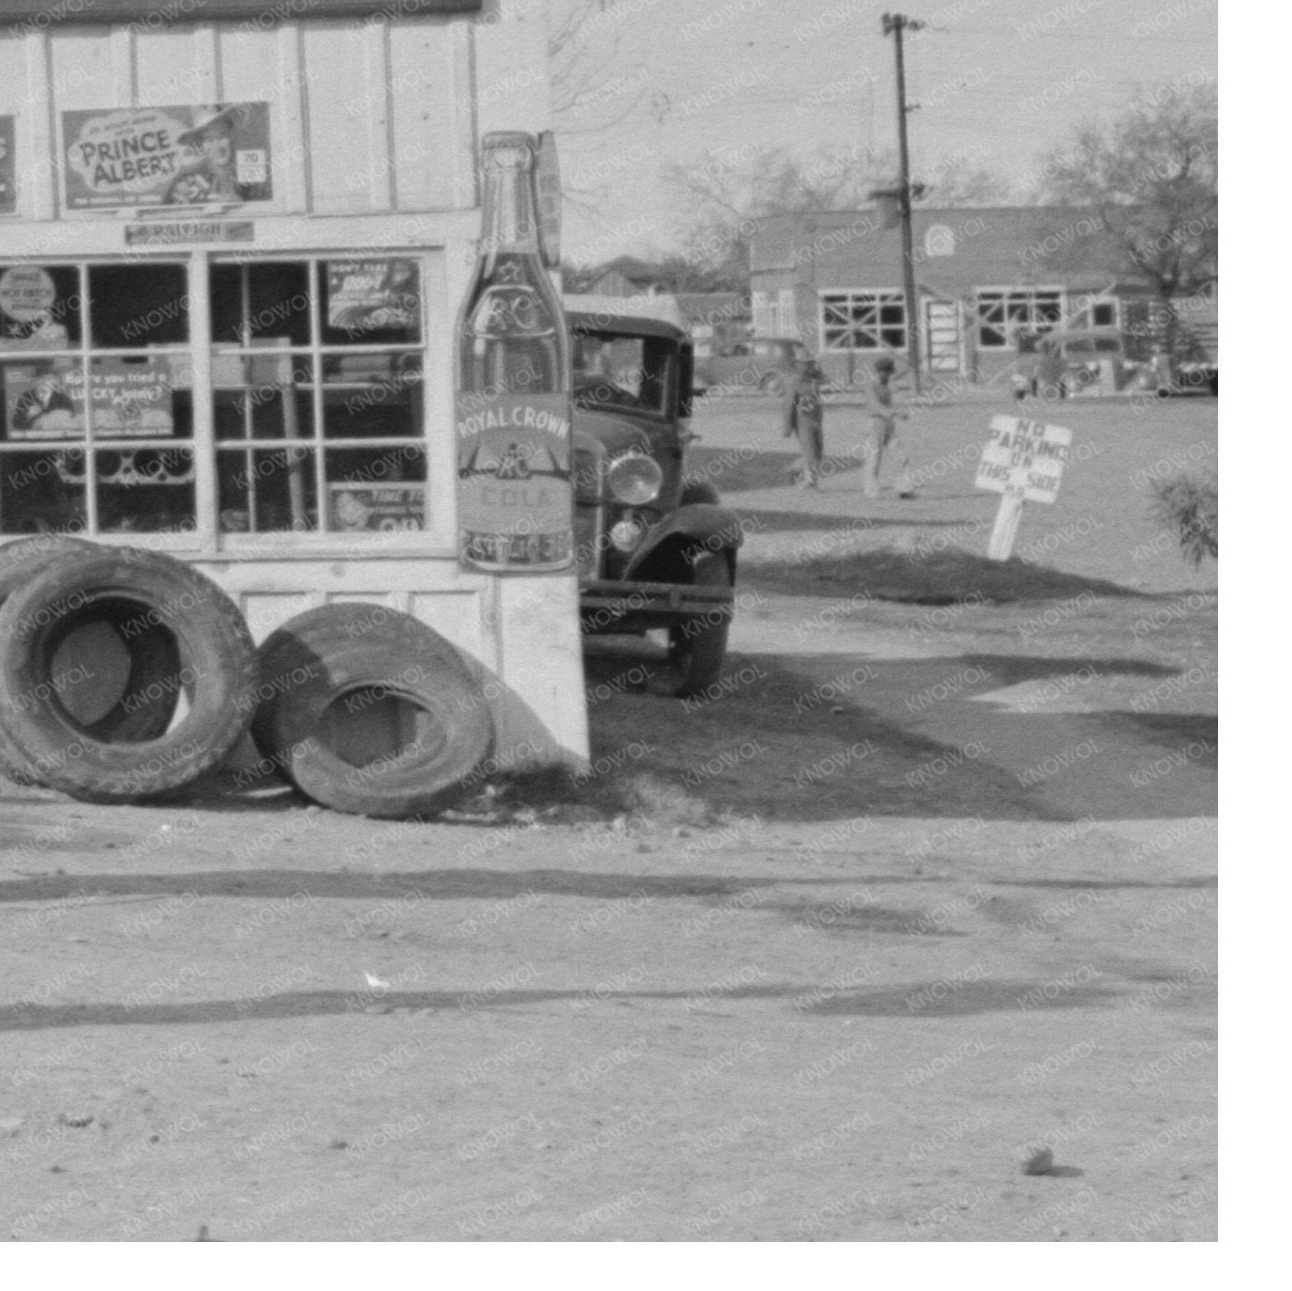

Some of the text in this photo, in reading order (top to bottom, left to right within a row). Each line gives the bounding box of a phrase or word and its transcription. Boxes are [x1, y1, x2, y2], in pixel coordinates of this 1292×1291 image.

[78, 129, 172, 166] PRINCE
[92, 151, 178, 188] ALBERT
[153, 224, 222, 237] RALEIGH
[64, 372, 101, 385] Hae
[104, 376, 126, 387] you
[128, 372, 156, 383] tried
[457, 405, 571, 440] ROYAL CROWN
[1018, 417, 1047, 438] NO
[989, 428, 1069, 461] PARKING
[1011, 452, 1033, 469] ON
[979, 461, 1012, 482] THIS
[1027, 472, 1060, 494] SIDE
[481, 486, 551, 508] COLA
